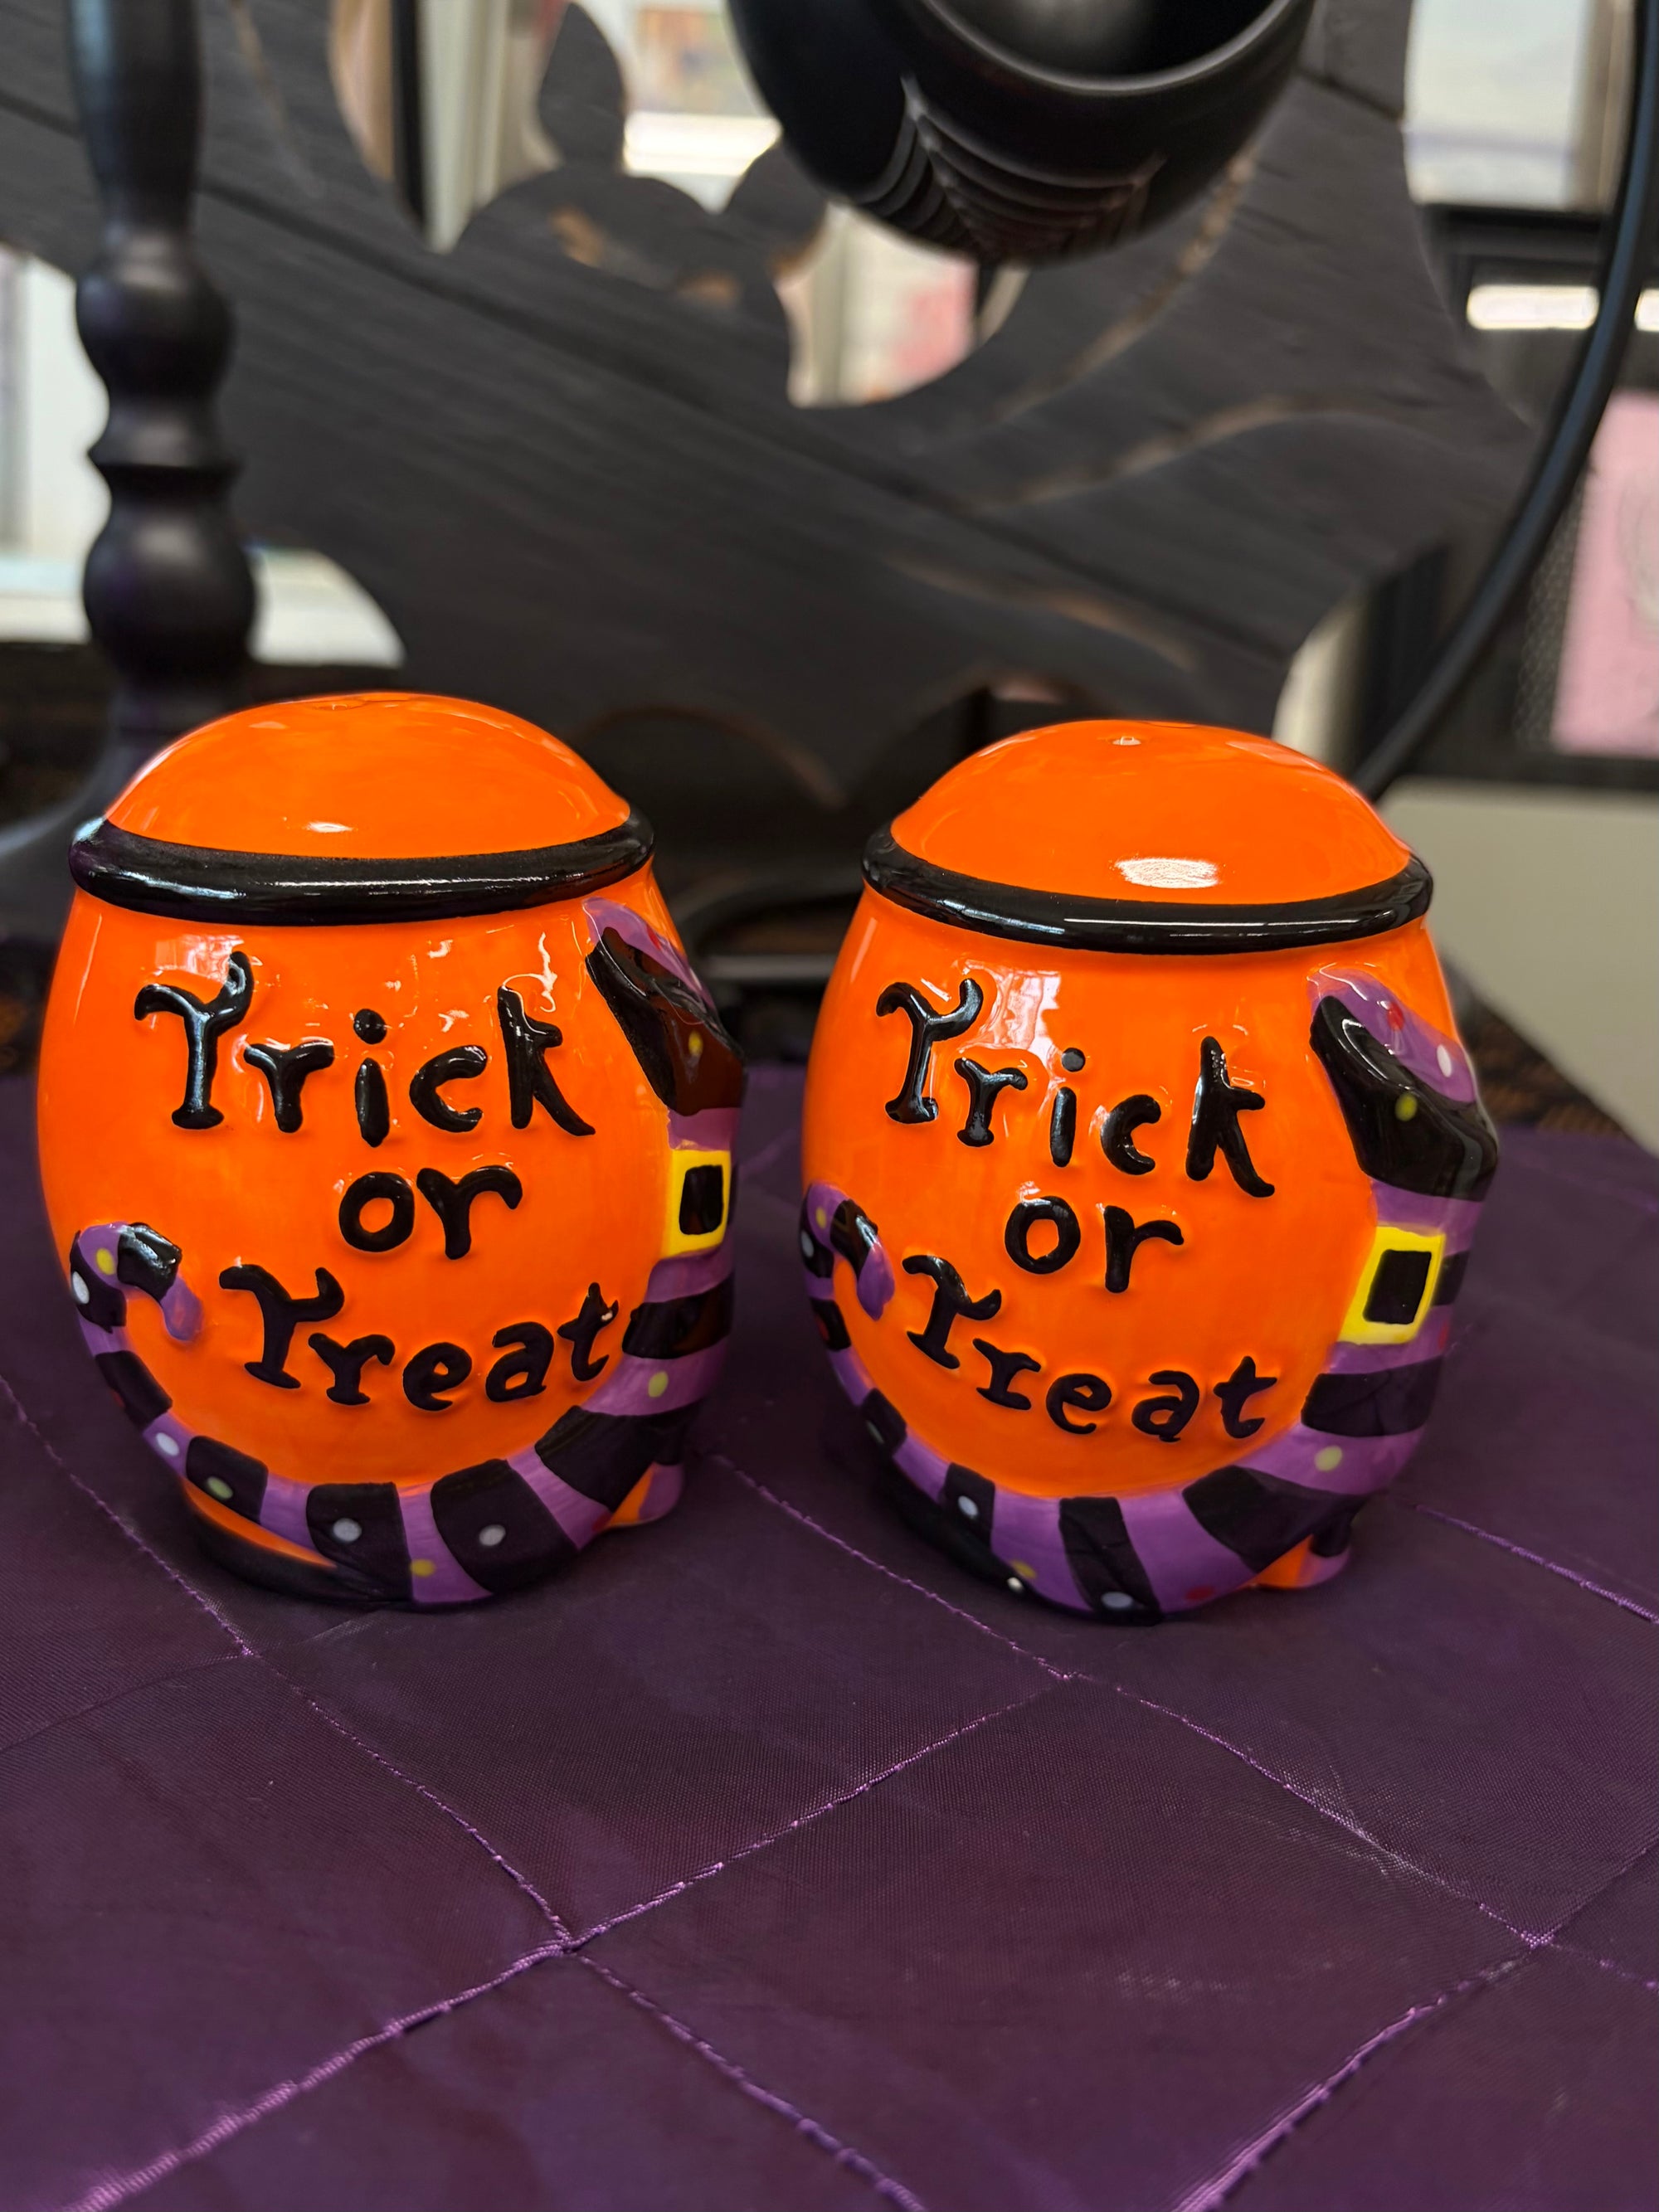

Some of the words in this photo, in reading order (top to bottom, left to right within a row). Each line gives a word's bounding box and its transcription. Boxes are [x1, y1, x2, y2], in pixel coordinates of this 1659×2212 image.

[134, 951, 596, 1147] Trick
[876, 978, 1276, 1198] Trick
[338, 1164, 523, 1259] or
[1005, 1195, 1184, 1293] or
[219, 1265, 619, 1412] Treat
[902, 1254, 1277, 1442] Treat
